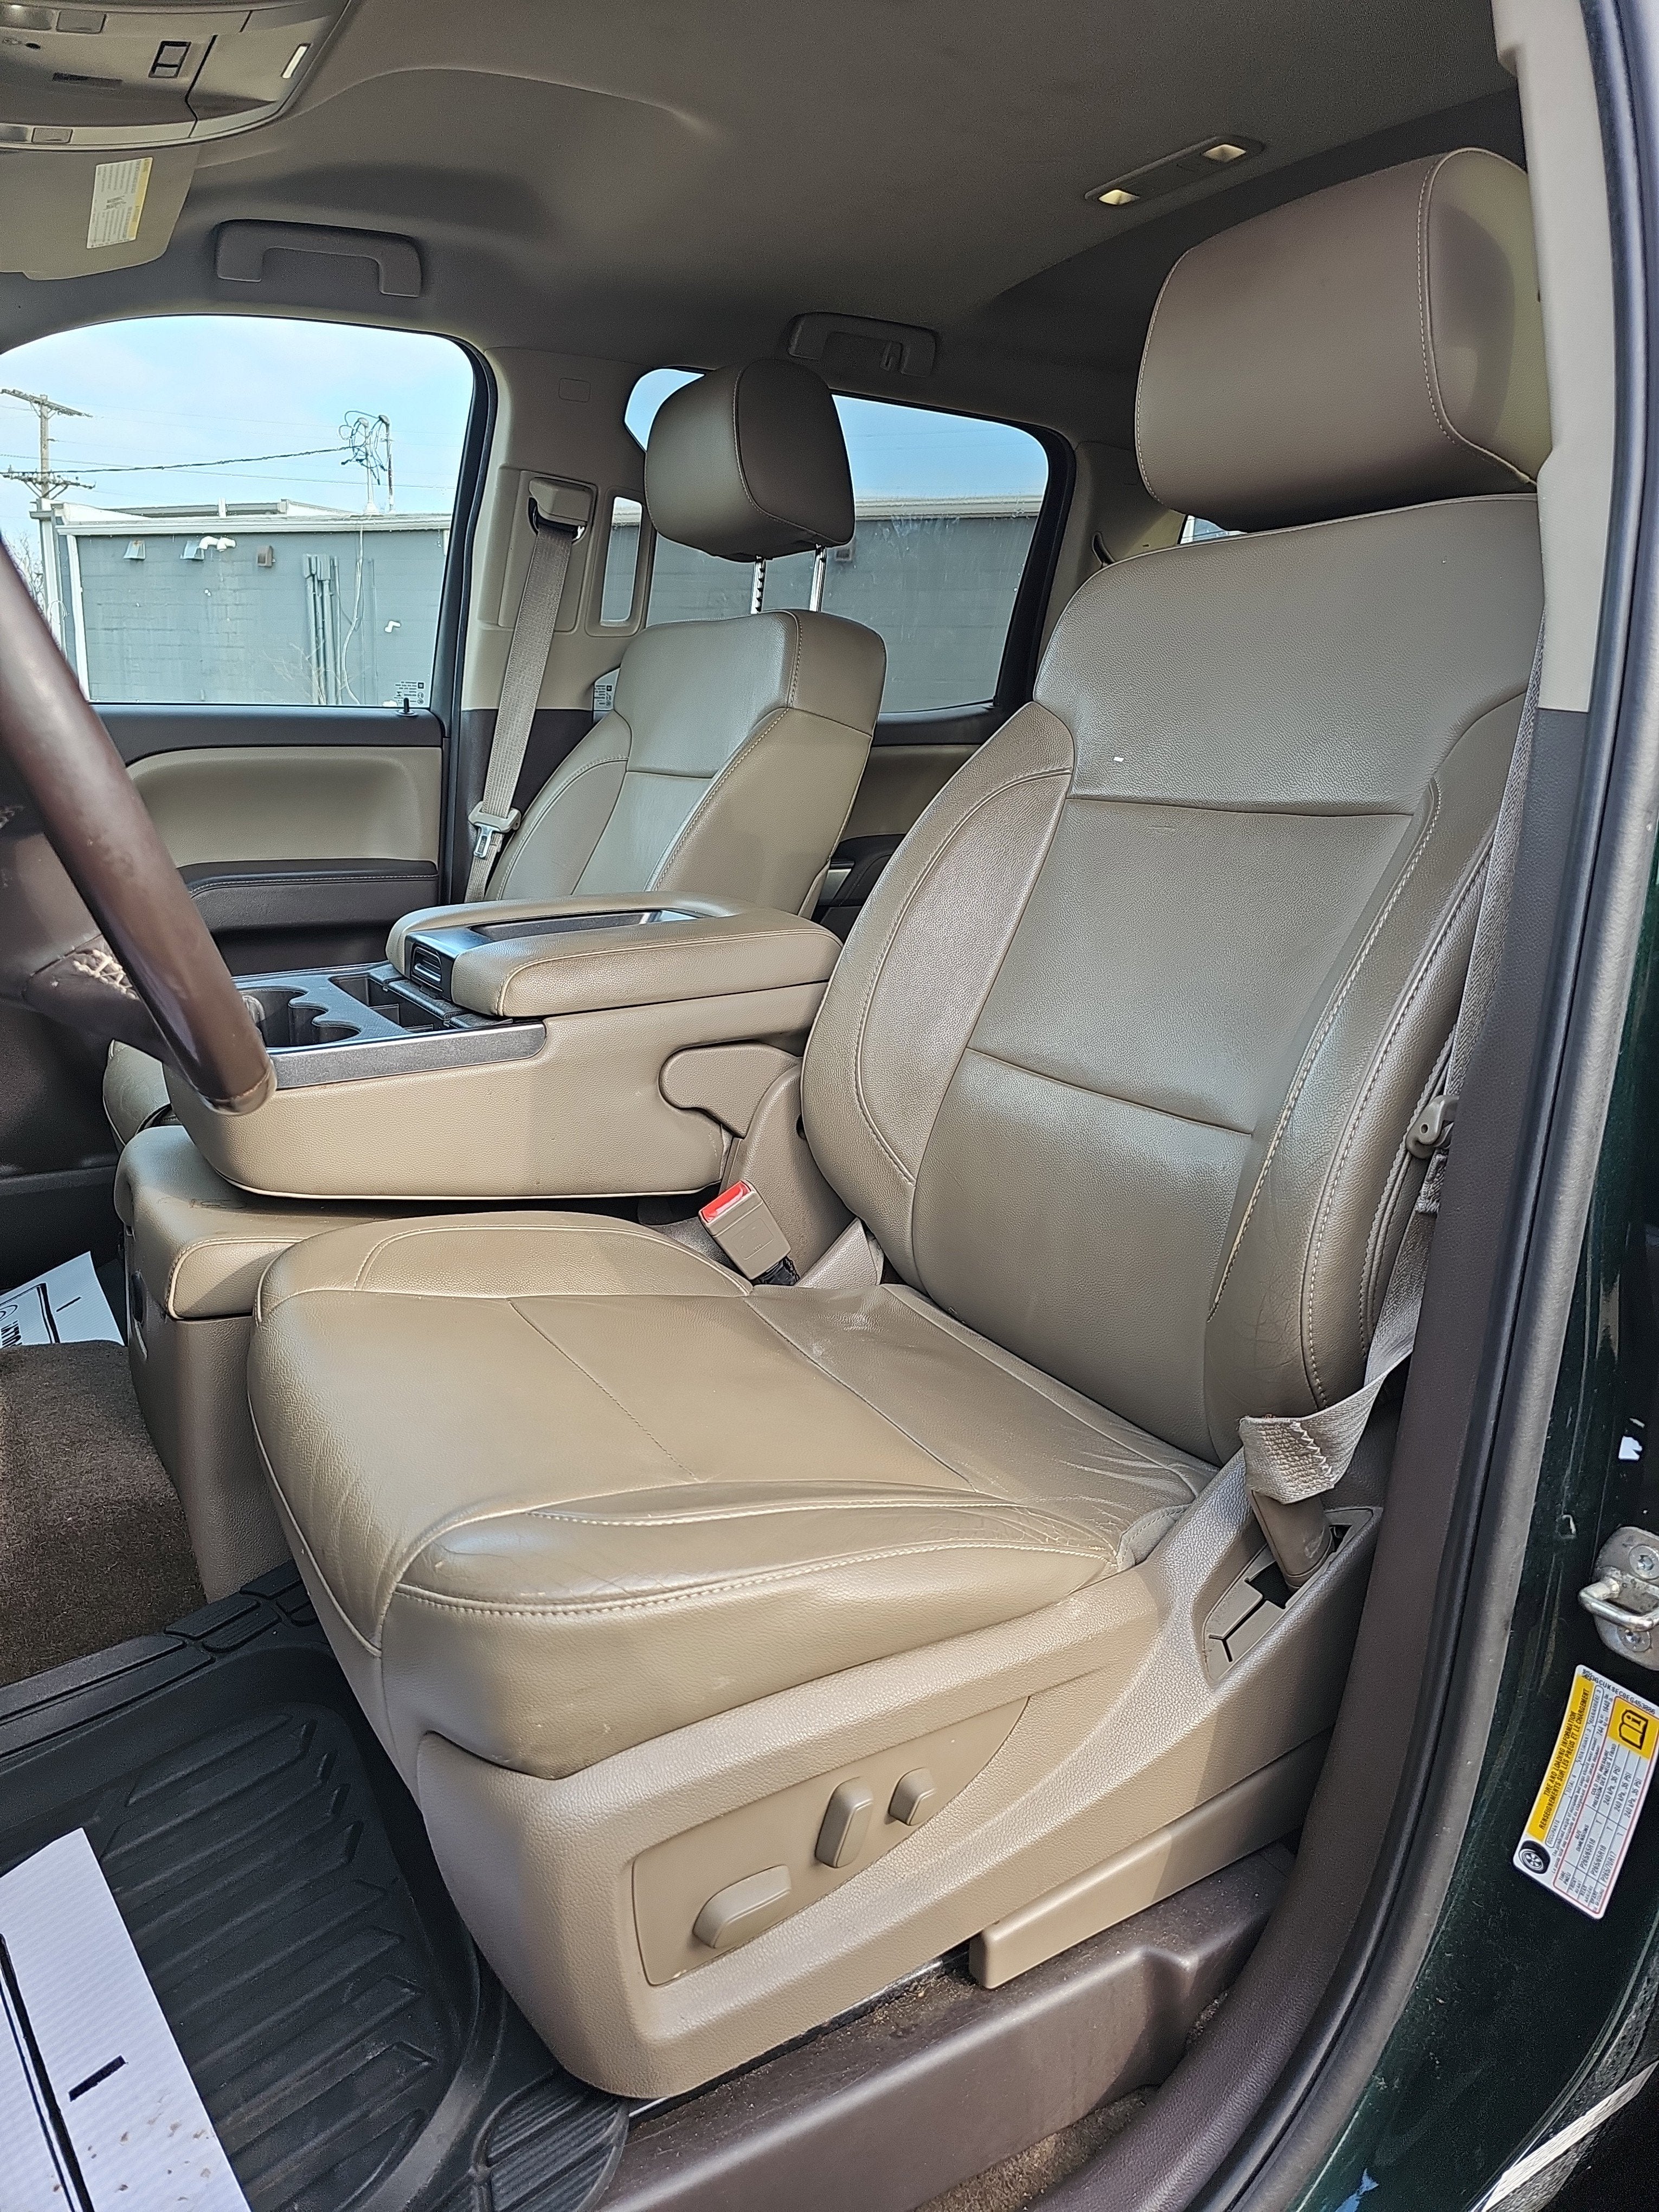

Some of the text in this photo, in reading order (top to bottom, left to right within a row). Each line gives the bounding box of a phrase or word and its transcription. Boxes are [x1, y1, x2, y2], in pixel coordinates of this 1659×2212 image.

[1574, 1687, 1590, 1725] CHARGEMENT
[1570, 1732, 1578, 1740] ET
[1572, 1723, 1580, 1732] LE
[1543, 1710, 1577, 1797] TIRE AND LOADING INFORMATION
[1560, 1758, 1569, 1770] LES
[1564, 1739, 1576, 1759] PNEUS
[1556, 1768, 1566, 1782] SUR
[1566, 1779, 1574, 1793] TOTAL
[1603, 1793, 1611, 1805] 240
[1612, 1764, 1621, 1775] PSI
[1538, 1780, 1561, 1830] RENSEIGNEMENTS
[1613, 1800, 1622, 1812] 240
[1623, 1771, 1631, 1782] PSI
[1624, 1806, 1632, 1818] 240
[1634, 1777, 1642, 1788] PSI
[1547, 1818, 1559, 1845] OCCUPANTS
[1579, 1837, 1595, 1869] P265/65R18
[1590, 1844, 1606, 1876] P265/65R18
[1600, 1850, 1617, 1883] P265/70R17
[1562, 1871, 1571, 1885] PNEU
